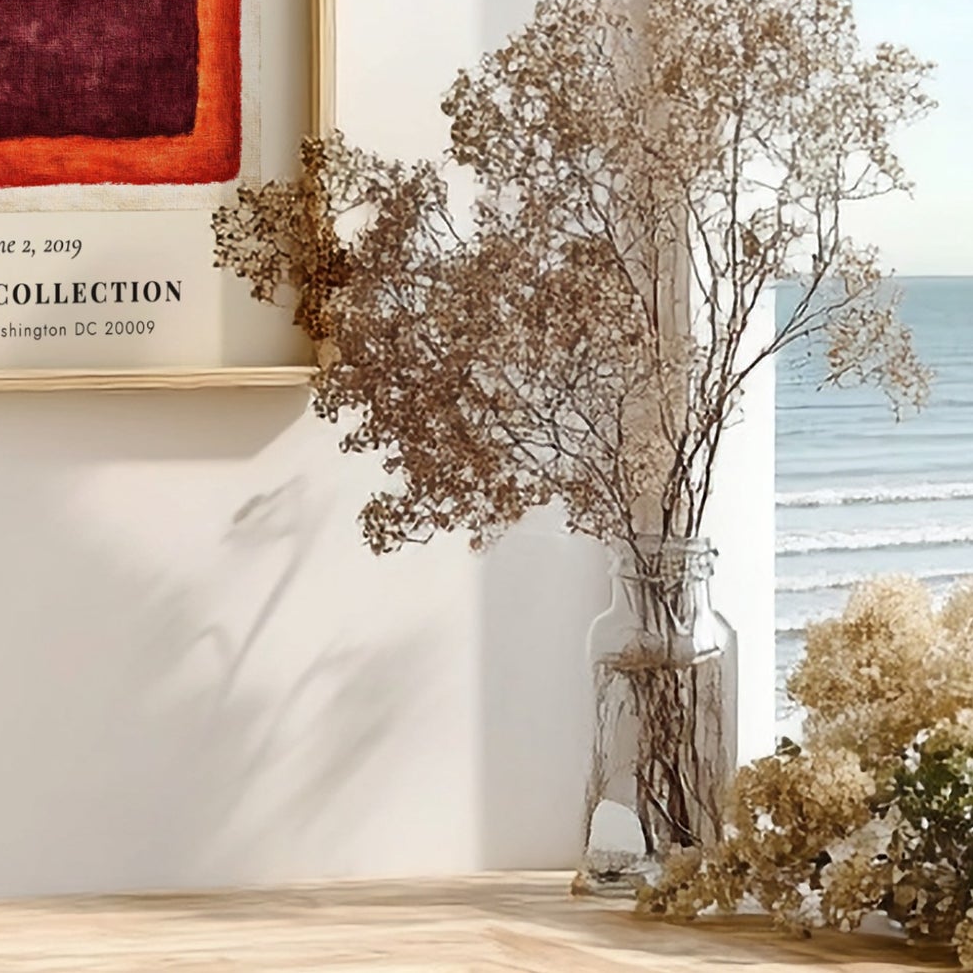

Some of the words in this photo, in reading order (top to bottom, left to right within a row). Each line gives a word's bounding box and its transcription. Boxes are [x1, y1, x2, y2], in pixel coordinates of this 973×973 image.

[21, 239, 36, 258] 2,
[43, 238, 83, 260] 2019
[74, 321, 98, 337] DC
[104, 319, 156, 336] 20009
